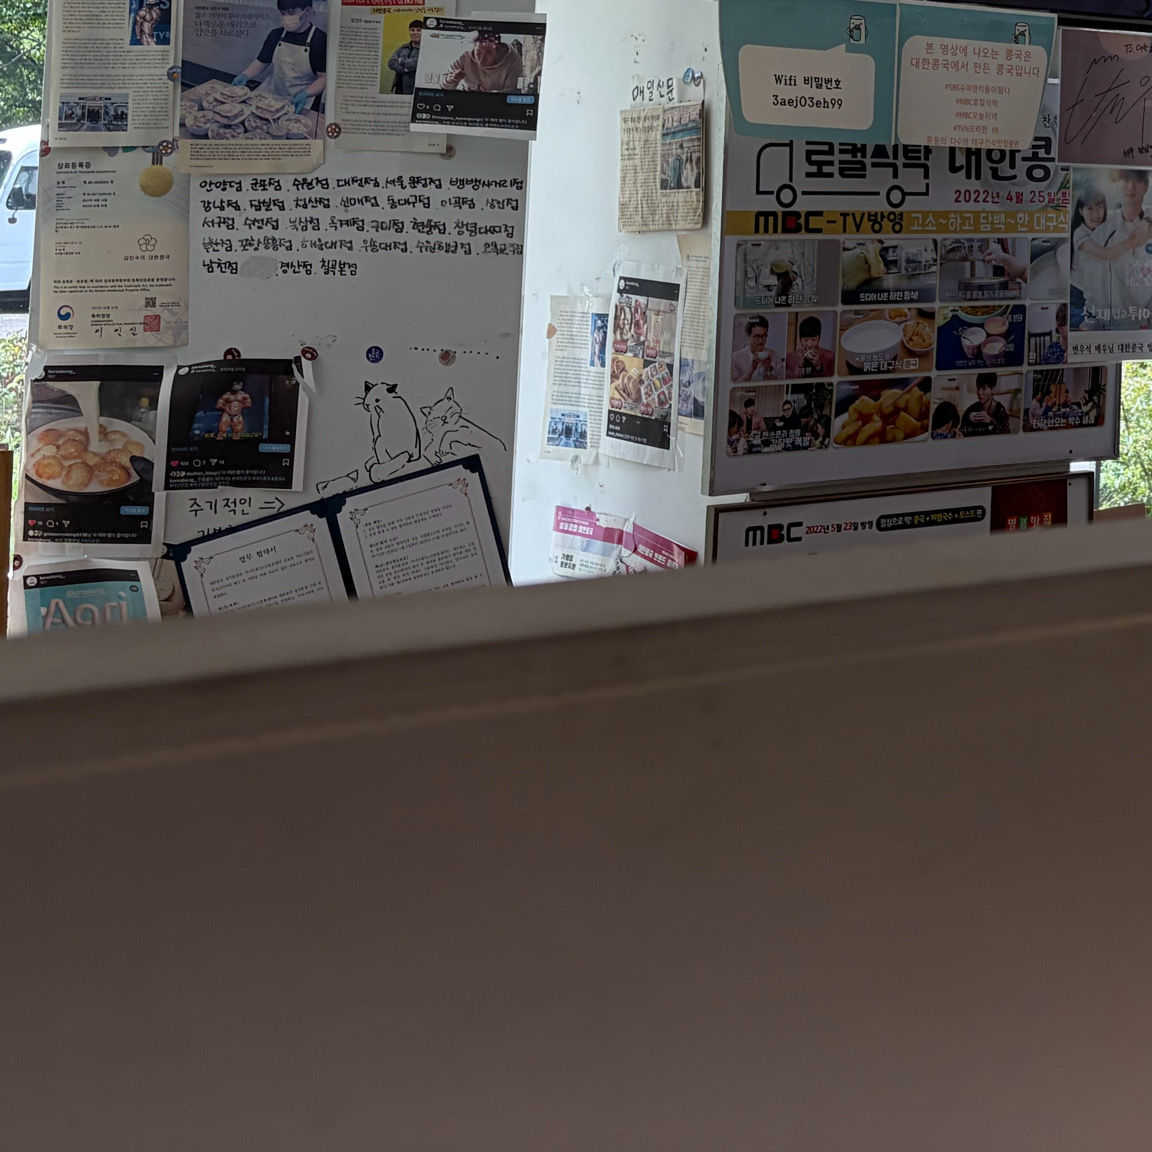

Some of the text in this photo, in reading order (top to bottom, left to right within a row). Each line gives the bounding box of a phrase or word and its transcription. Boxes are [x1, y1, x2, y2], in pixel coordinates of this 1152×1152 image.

[925, 42, 1032, 62] 본 영상에 나오는 콩국은
[910, 57, 1040, 78] 대한콩국에서 만든 콩국입니다
[632, 77, 675, 102] 매일신문
[774, 74, 842, 90] Wifi 비밀번호
[944, 83, 1011, 95] #SBS슈퍼맨이돌아왔다
[955, 97, 999, 108] #MBC로컬식탁
[955, 111, 998, 121] #MBC오늘저녁
[953, 124, 999, 134] #TVN프리한 19
[805, 136, 1069, 183] 로컬식탁 대한콩
[954, 189, 1056, 205] 2022년 4월 25일
[910, 212, 975, 231] 고소~하고
[980, 212, 1030, 231] 담백~한
[1094, 343, 1114, 354] 배우님
[1117, 342, 1144, 353] 대한콩국
[189, 496, 252, 517] 주기적인
[744, 520, 874, 548] MBC 2022년 5월 23일 방영
